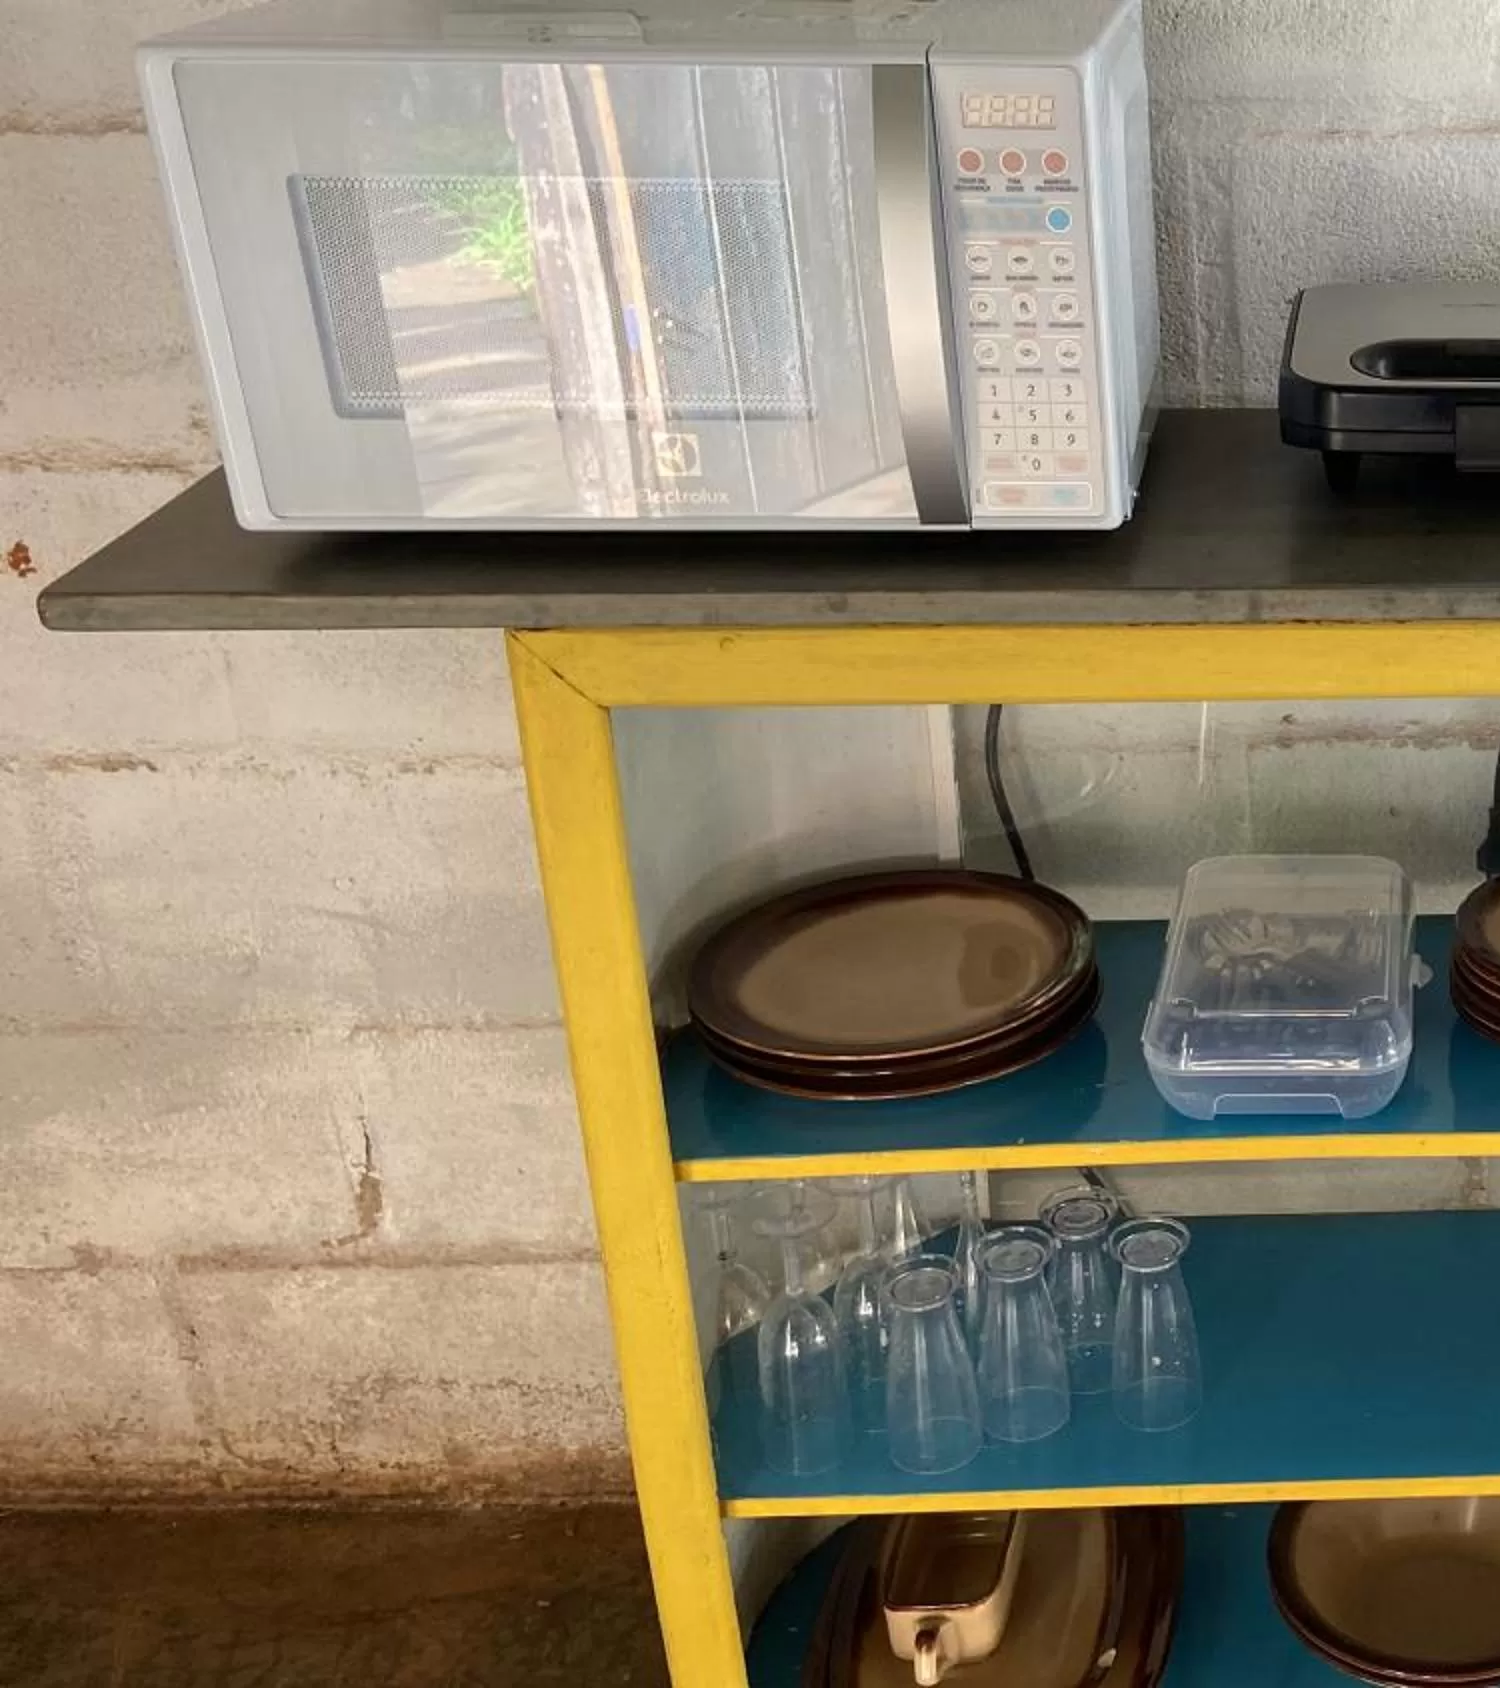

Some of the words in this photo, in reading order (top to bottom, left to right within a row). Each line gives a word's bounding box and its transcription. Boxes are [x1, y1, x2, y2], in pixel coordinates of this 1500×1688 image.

[991, 384, 998, 397] 1
[1027, 383, 1037, 397] 2
[1064, 383, 1073, 397] 3
[991, 409, 1001, 421] 4
[1029, 409, 1038, 422] 5
[1065, 409, 1075, 423] 6
[993, 433, 1002, 445] 7
[1030, 433, 1039, 446] 8
[1067, 433, 1076, 446] 9
[1031, 457, 1041, 471] 0
